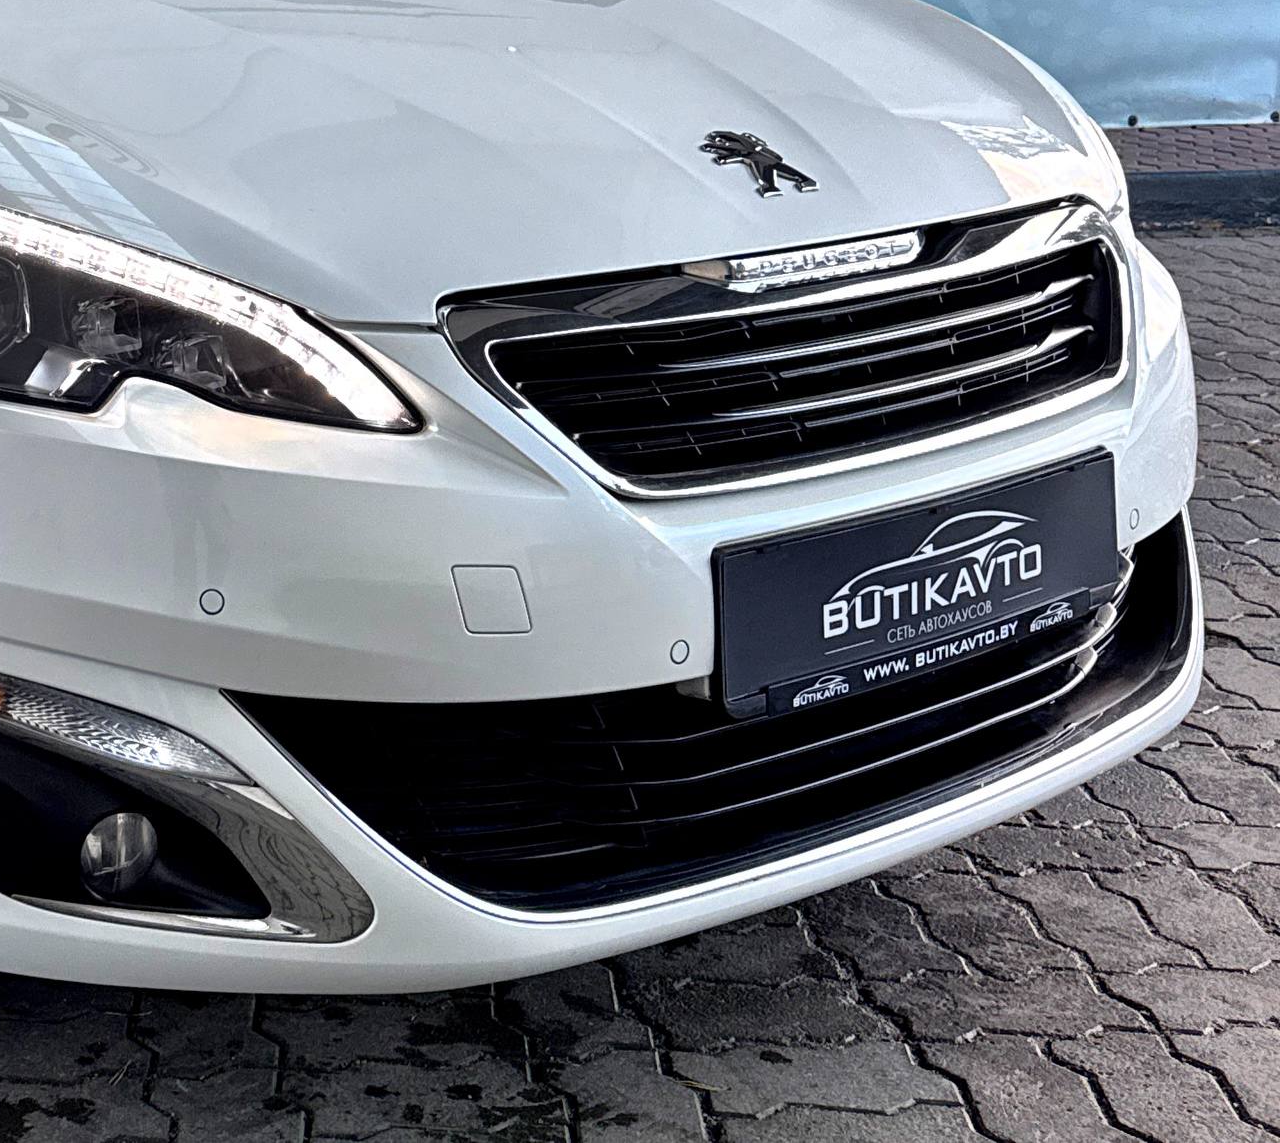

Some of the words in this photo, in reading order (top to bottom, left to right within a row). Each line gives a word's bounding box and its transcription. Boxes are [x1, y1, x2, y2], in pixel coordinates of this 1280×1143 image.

[822, 543, 1042, 638] BUTIKAVTO
[886, 624, 916, 644] СЕТЬ
[918, 600, 992, 636] АВТОХАУСОВ
[1029, 609, 1073, 633] BUTIKAVTO
[915, 620, 1019, 668] BUTIKAVTO.BY
[792, 683, 849, 708] BUTIKAVTO
